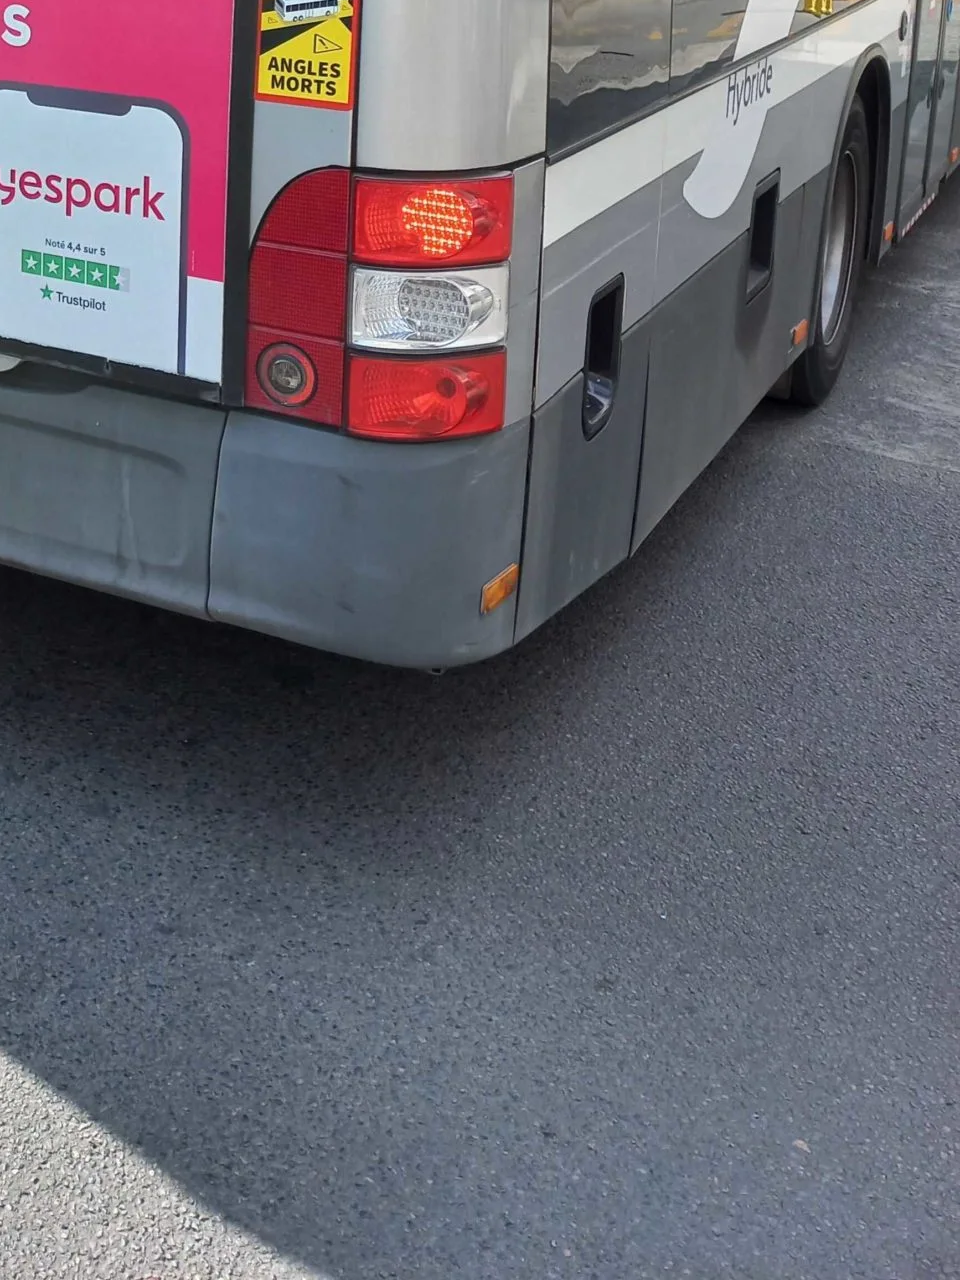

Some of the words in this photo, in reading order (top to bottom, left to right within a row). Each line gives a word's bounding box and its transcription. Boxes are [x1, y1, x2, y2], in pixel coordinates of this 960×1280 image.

[268, 56, 341, 78] ANGLES
[271, 74, 337, 96] MORTS
[726, 56, 773, 126] Hybride
[45, 238, 65, 250] Noté
[67, 242, 81, 253] 4,4
[83, 246, 98, 255] sur
[100, 248, 106, 256] 5
[56, 291, 106, 311] Trustpilot
